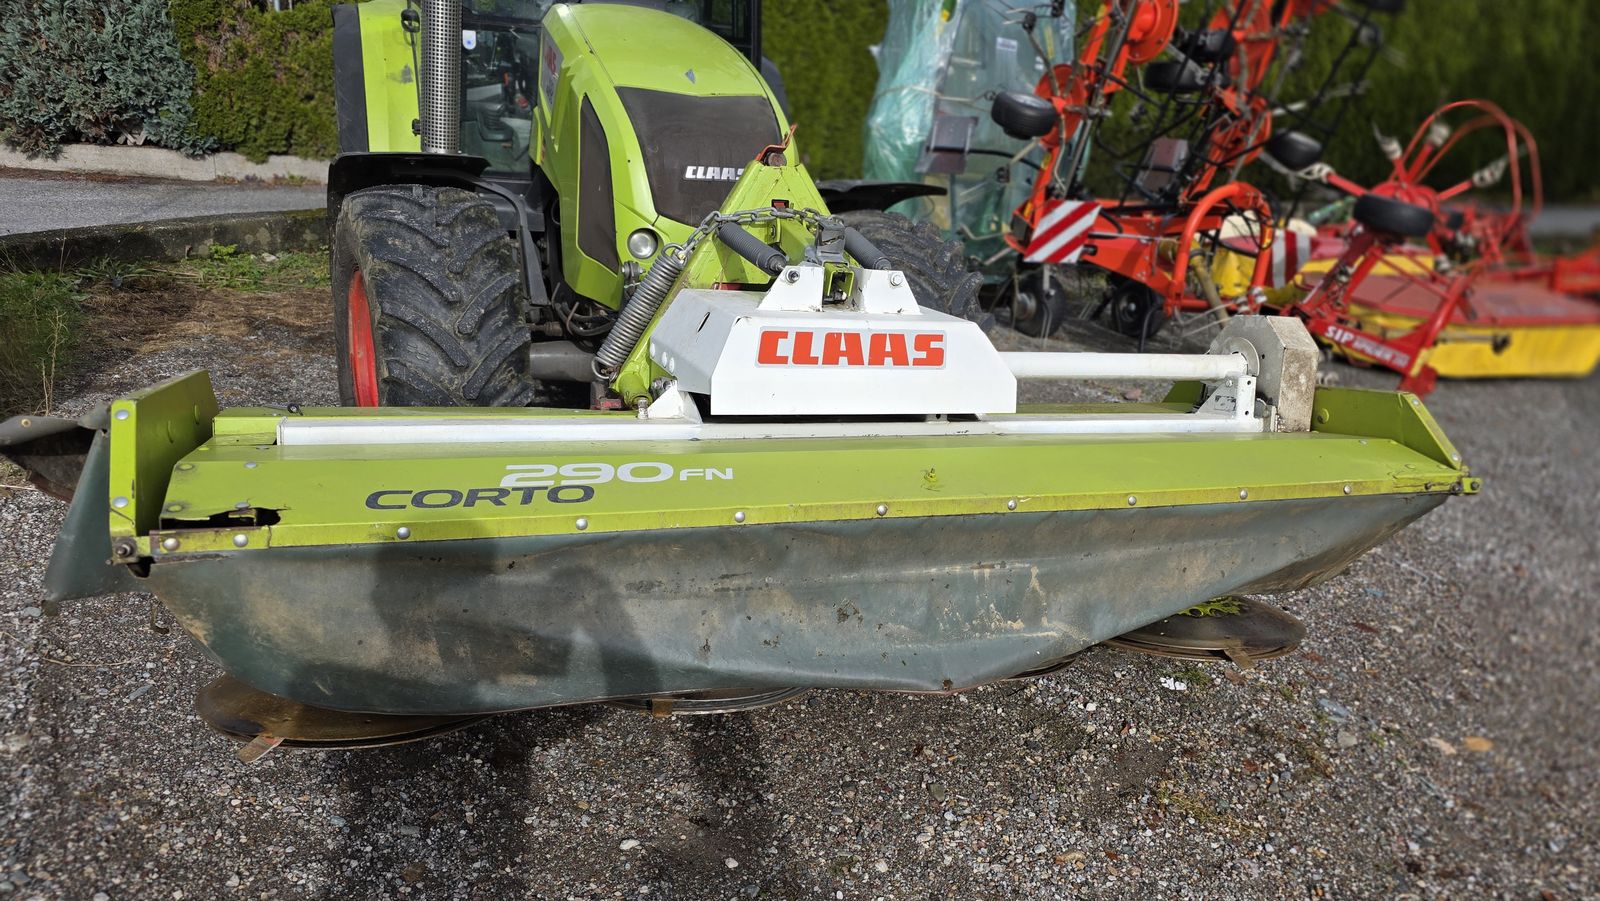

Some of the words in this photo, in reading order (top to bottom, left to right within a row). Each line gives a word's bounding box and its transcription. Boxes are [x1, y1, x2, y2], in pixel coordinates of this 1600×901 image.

[1324, 325, 1355, 344] SIP
[757, 330, 945, 366] CLAAS
[500, 461, 674, 487] 290
[679, 467, 734, 481] FN
[365, 484, 595, 510] CORTO
